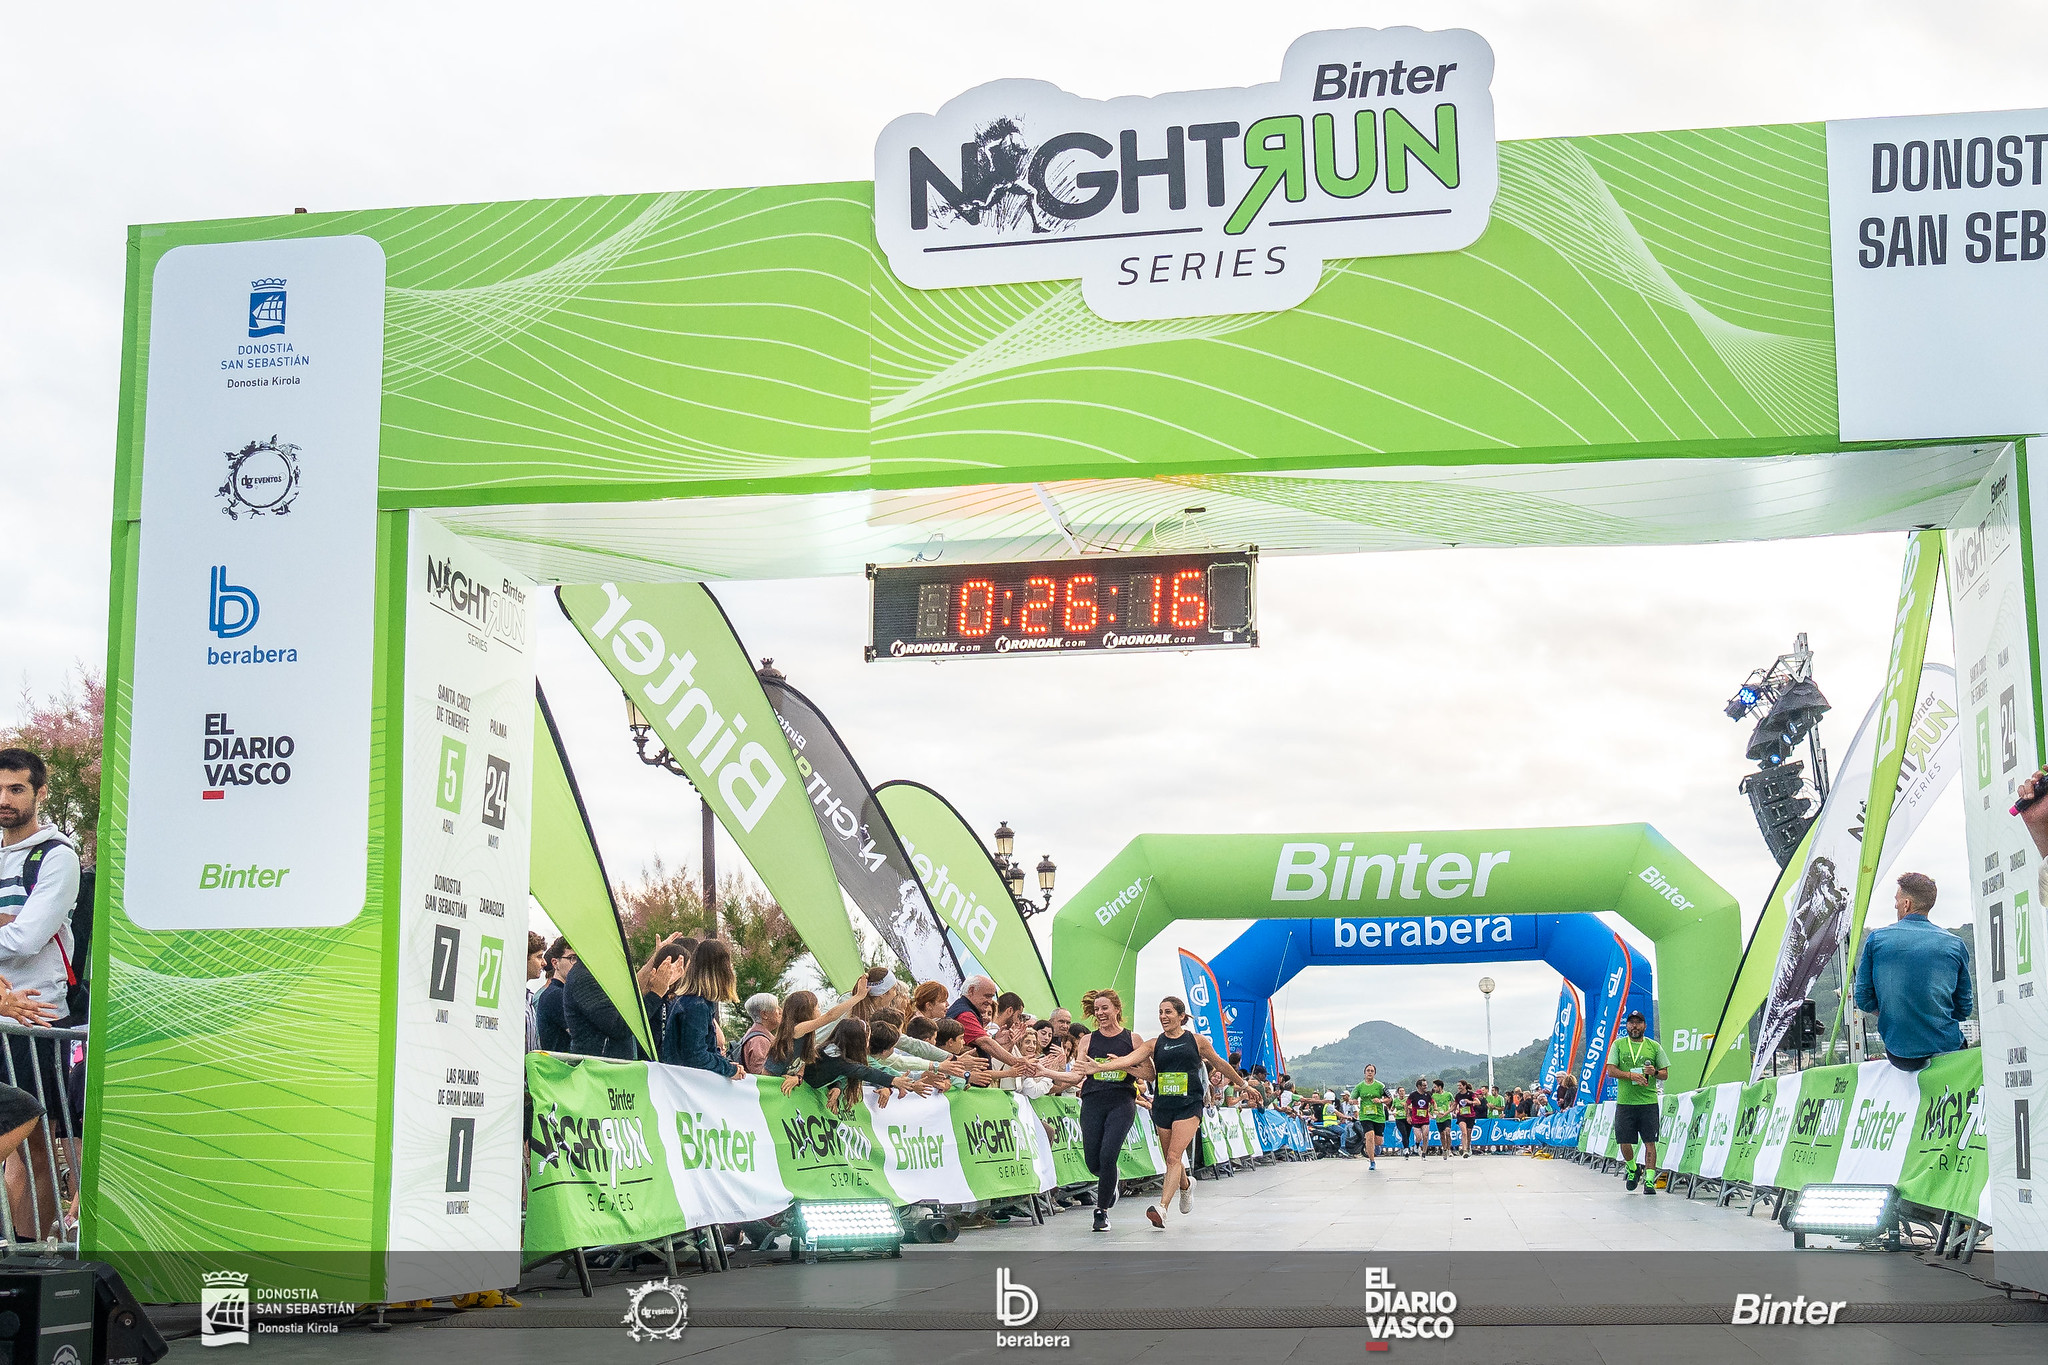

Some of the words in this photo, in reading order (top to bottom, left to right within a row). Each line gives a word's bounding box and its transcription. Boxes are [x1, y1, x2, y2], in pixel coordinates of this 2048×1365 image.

[1313, 60, 1457, 101] Binter
[1859, 214, 1947, 268] SAN
[1965, 209, 2048, 263] SEB
[1118, 246, 1288, 286] SERIES
[221, 360, 244, 370] SAN
[247, 355, 310, 369] SEBASTIÁN
[238, 343, 294, 355] DONOSTIA
[227, 377, 269, 388] Donostia
[272, 376, 301, 386] Kirola
[241, 475, 253, 489] dg
[254, 475, 282, 485] EVENTOS
[502, 578, 526, 604] Binter
[207, 645, 297, 665] berabera
[467, 632, 488, 653] SERIES
[889, 638, 981, 658] KRONOAK.com
[995, 634, 1087, 655] KRONOAK.com
[1102, 630, 1196, 651] KRONOAK.com
[437, 684, 456, 708] SANTA
[457, 692, 471, 713] CRUZ
[205, 713, 235, 735] EL
[436, 705, 445, 722] DE
[445, 708, 470, 734] TENERIFE
[489, 718, 508, 740] PALMA
[2001, 698, 2016, 763] 24
[204, 735, 295, 760] DIARIO
[1979, 721, 1988, 779] 5
[204, 762, 291, 786] VASCO
[444, 748, 458, 803] 5
[1909, 763, 1941, 808] SERIES
[484, 765, 507, 821] 24
[199, 863, 290, 889] Binter
[434, 874, 462, 896] DONOSTIA
[1271, 842, 1511, 901] Binter
[1094, 877, 1145, 927] Binter
[1639, 865, 1695, 912] Binter
[425, 894, 438, 913] SAN
[1334, 916, 1513, 948] berabera
[2016, 903, 2029, 965] 27
[438, 937, 452, 991] 7
[477, 946, 502, 1000] 27
[446, 1068, 457, 1084] LAS
[458, 1069, 479, 1086] PALMAS
[438, 1089, 446, 1105] DE
[446, 1089, 461, 1106] GRAN
[461, 1090, 485, 1108] CANARIA
[607, 1087, 636, 1111] Binter
[1850, 1098, 1907, 1151] Binter
[676, 1110, 757, 1173] Binter
[888, 1124, 944, 1171] Binter
[998, 1164, 1029, 1179] SERIES
